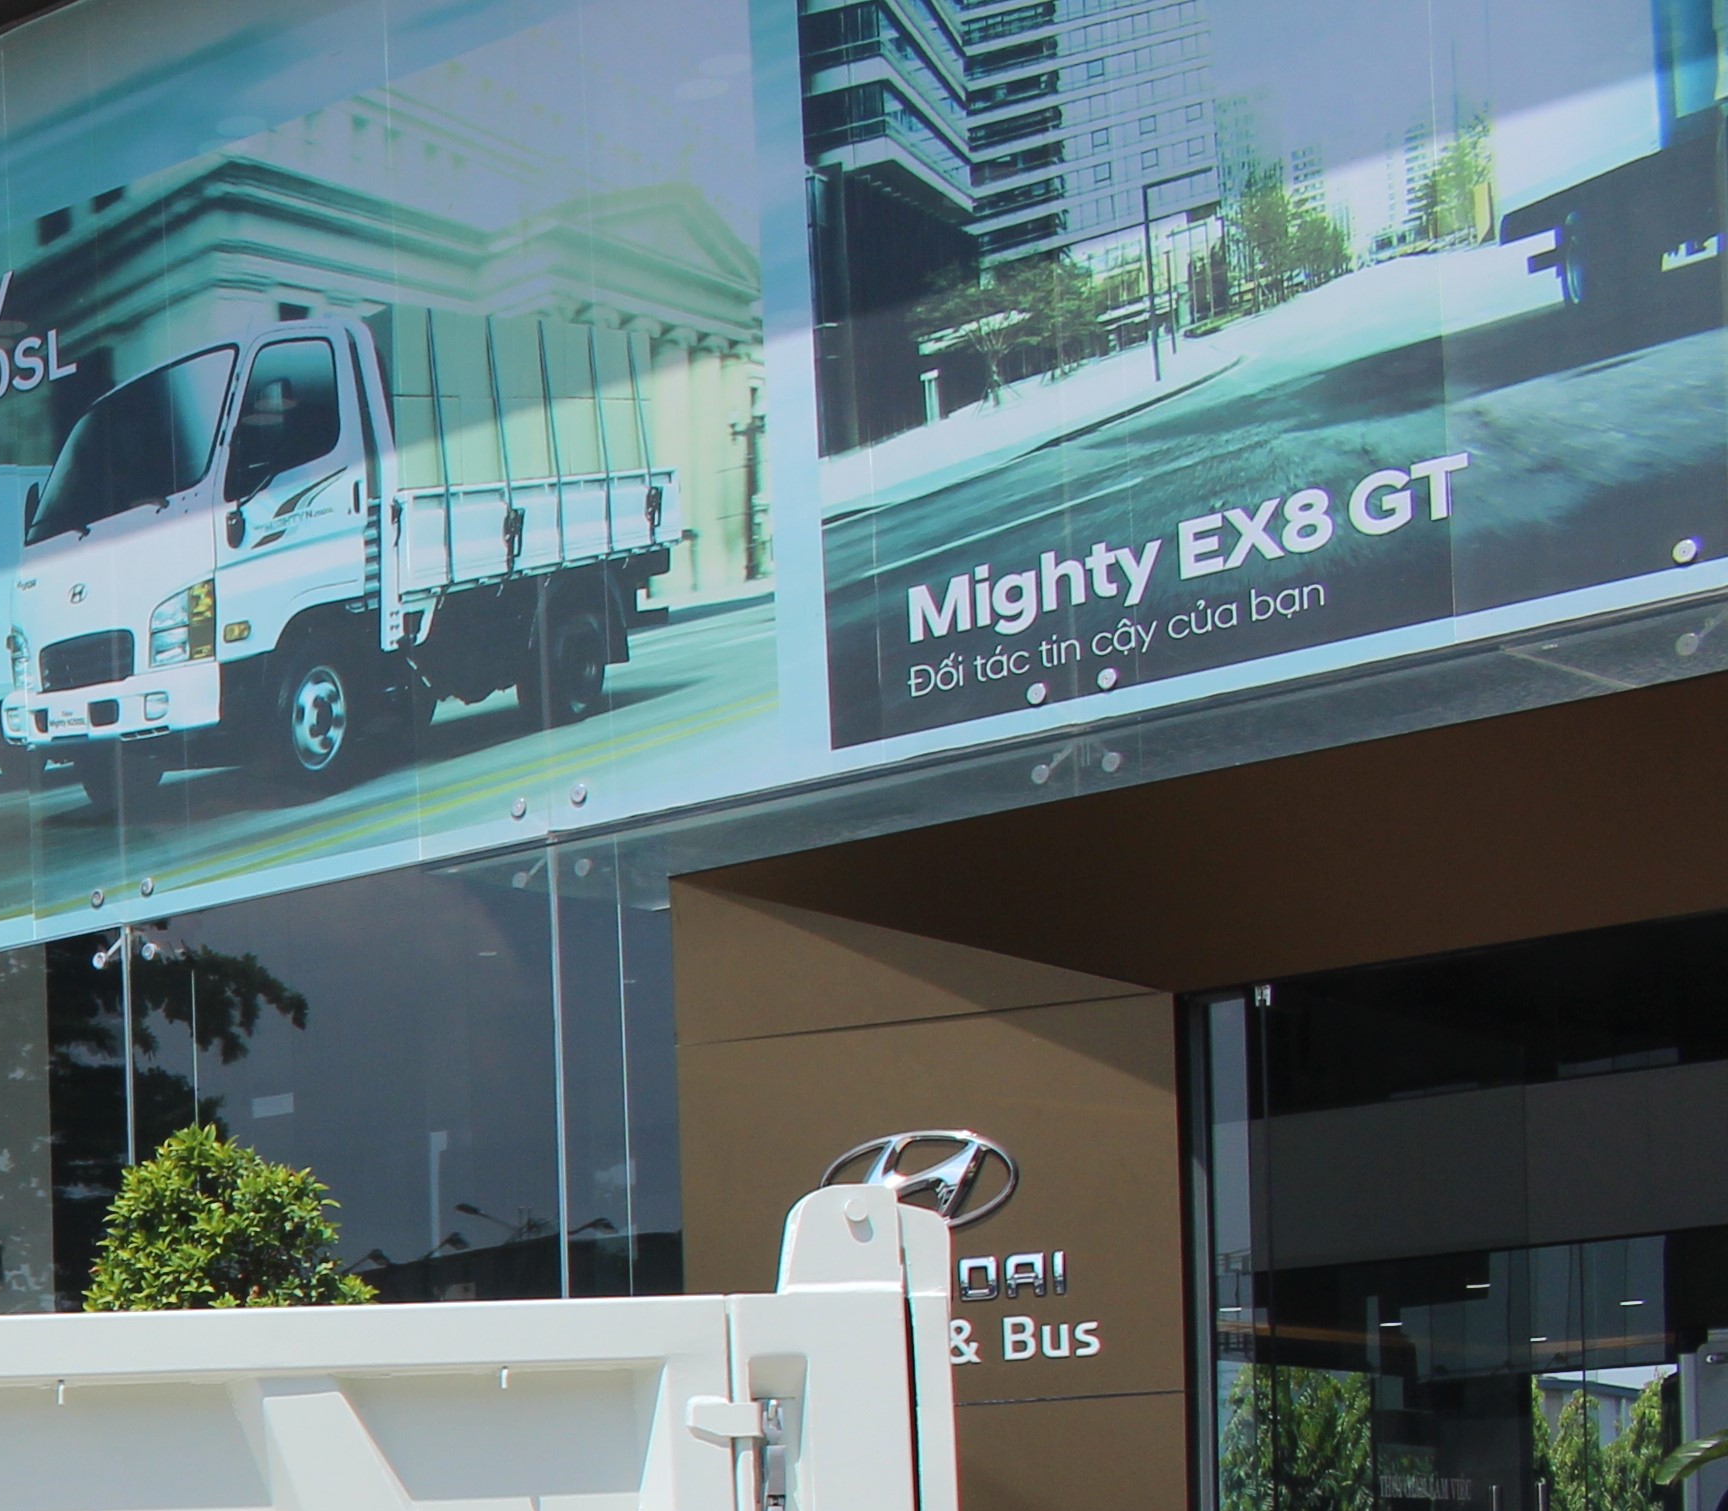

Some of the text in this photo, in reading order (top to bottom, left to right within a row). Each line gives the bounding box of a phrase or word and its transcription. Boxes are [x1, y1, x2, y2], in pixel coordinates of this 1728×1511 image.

[907, 452, 1470, 643] Mighty EX8 GT
[907, 582, 1325, 698] Đối tác tin cậy của bạn
[1003, 1315, 1101, 1361] Bus
